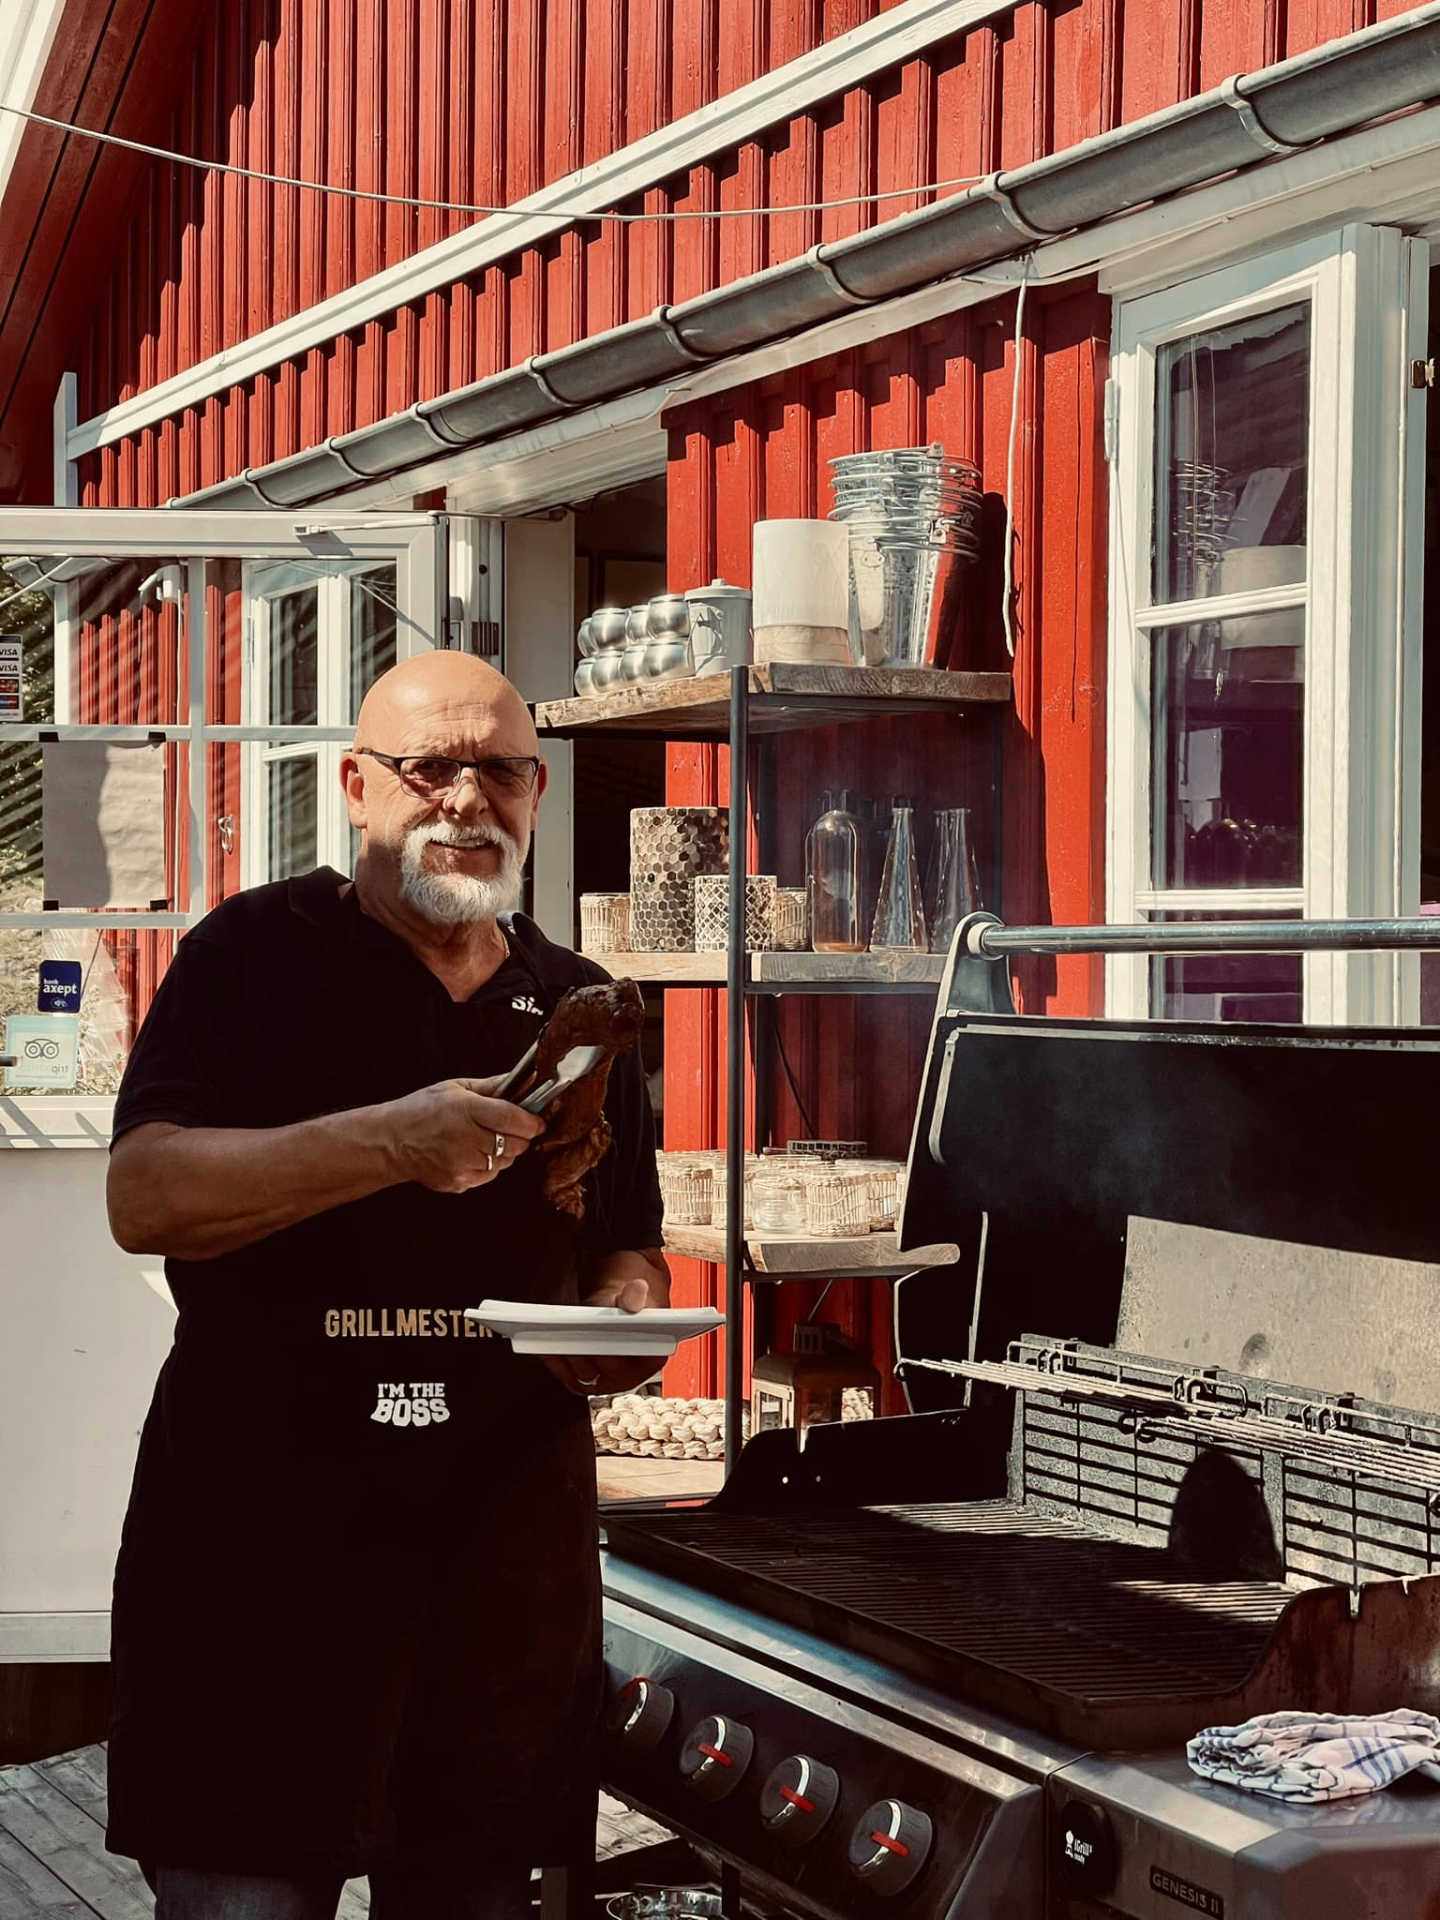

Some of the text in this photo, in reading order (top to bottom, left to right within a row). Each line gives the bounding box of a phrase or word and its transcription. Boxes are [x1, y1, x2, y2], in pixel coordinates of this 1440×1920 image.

[43, 983, 77, 997] axept
[377, 1383, 445, 1398] I'M THE
[370, 1398, 450, 1427] BOSS
[1152, 1872, 1207, 1908] GENESIS
